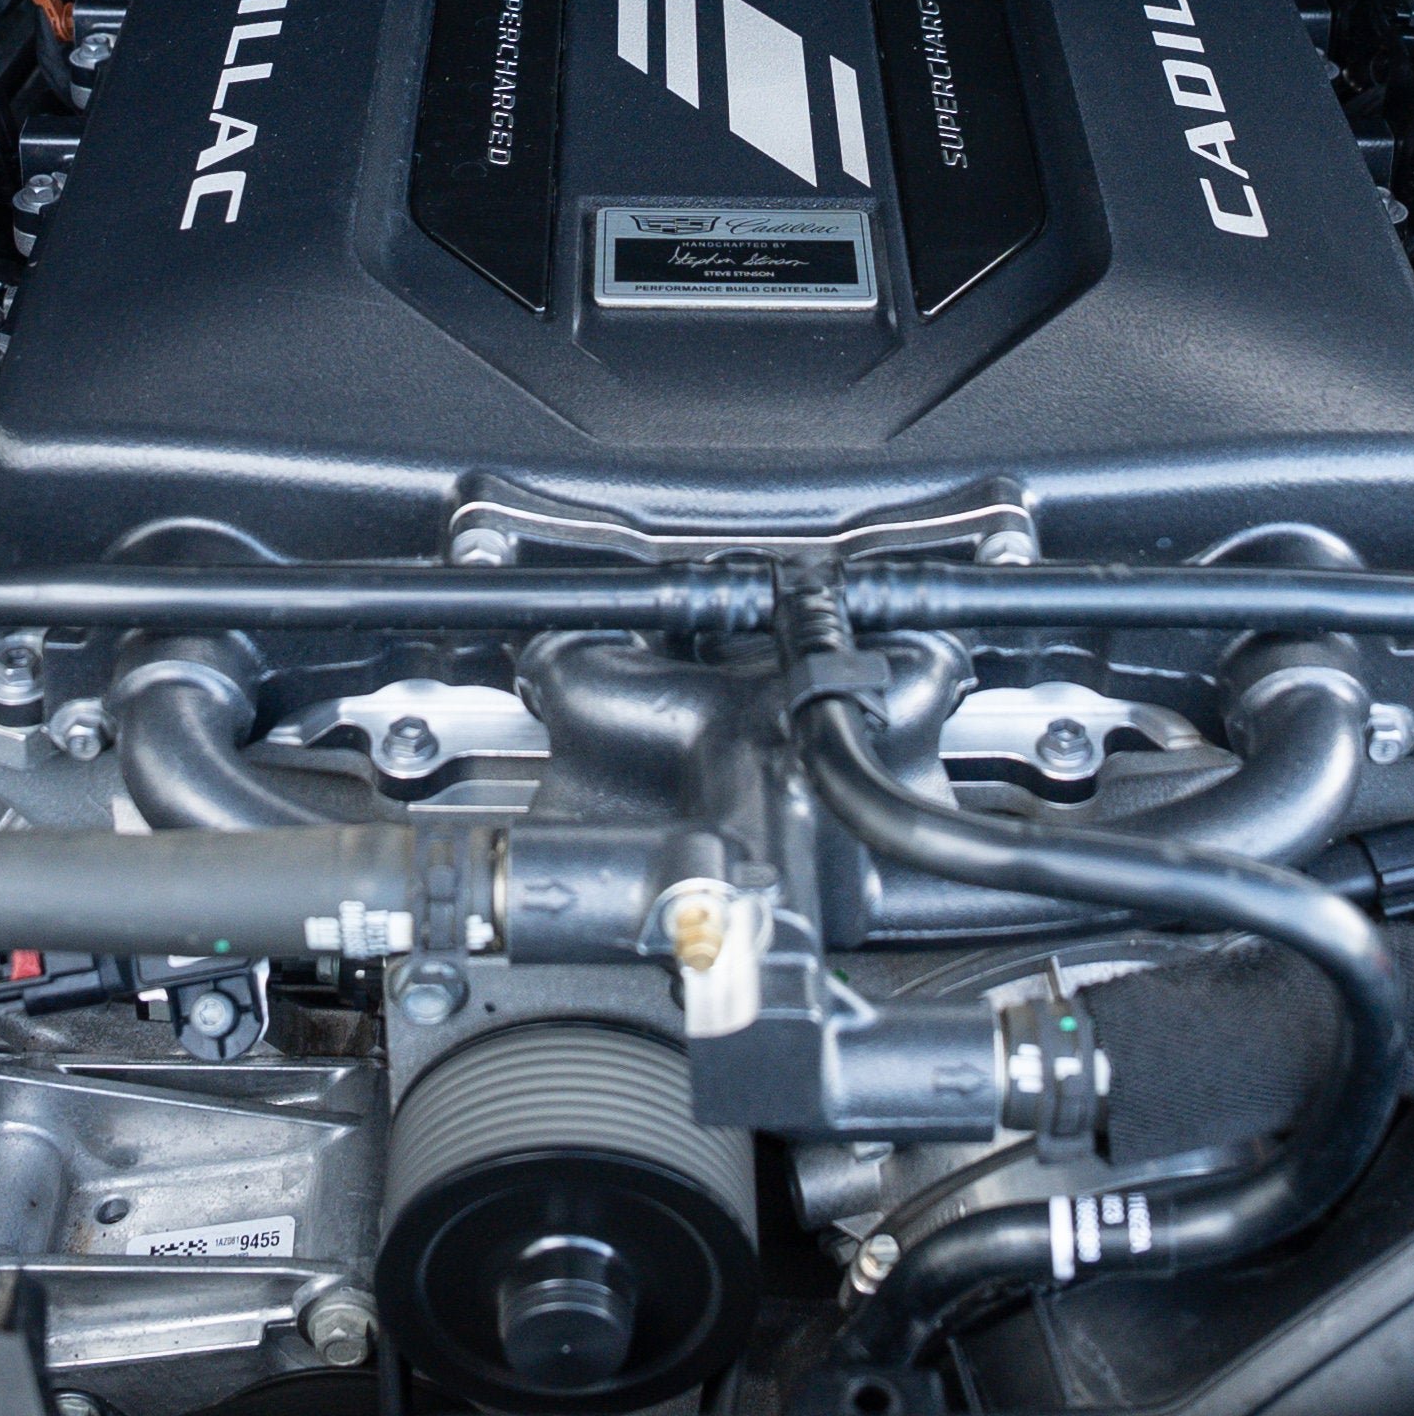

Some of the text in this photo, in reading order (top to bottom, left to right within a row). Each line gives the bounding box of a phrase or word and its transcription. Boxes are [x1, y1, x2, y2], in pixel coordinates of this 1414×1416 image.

[725, 217, 840, 235] Cadillac
[681, 241, 767, 249] HANDCRAFTED
[703, 270, 731, 278] STEVE
[635, 284, 722, 293] PERFORMANCE
[725, 285, 760, 293] BUILD
